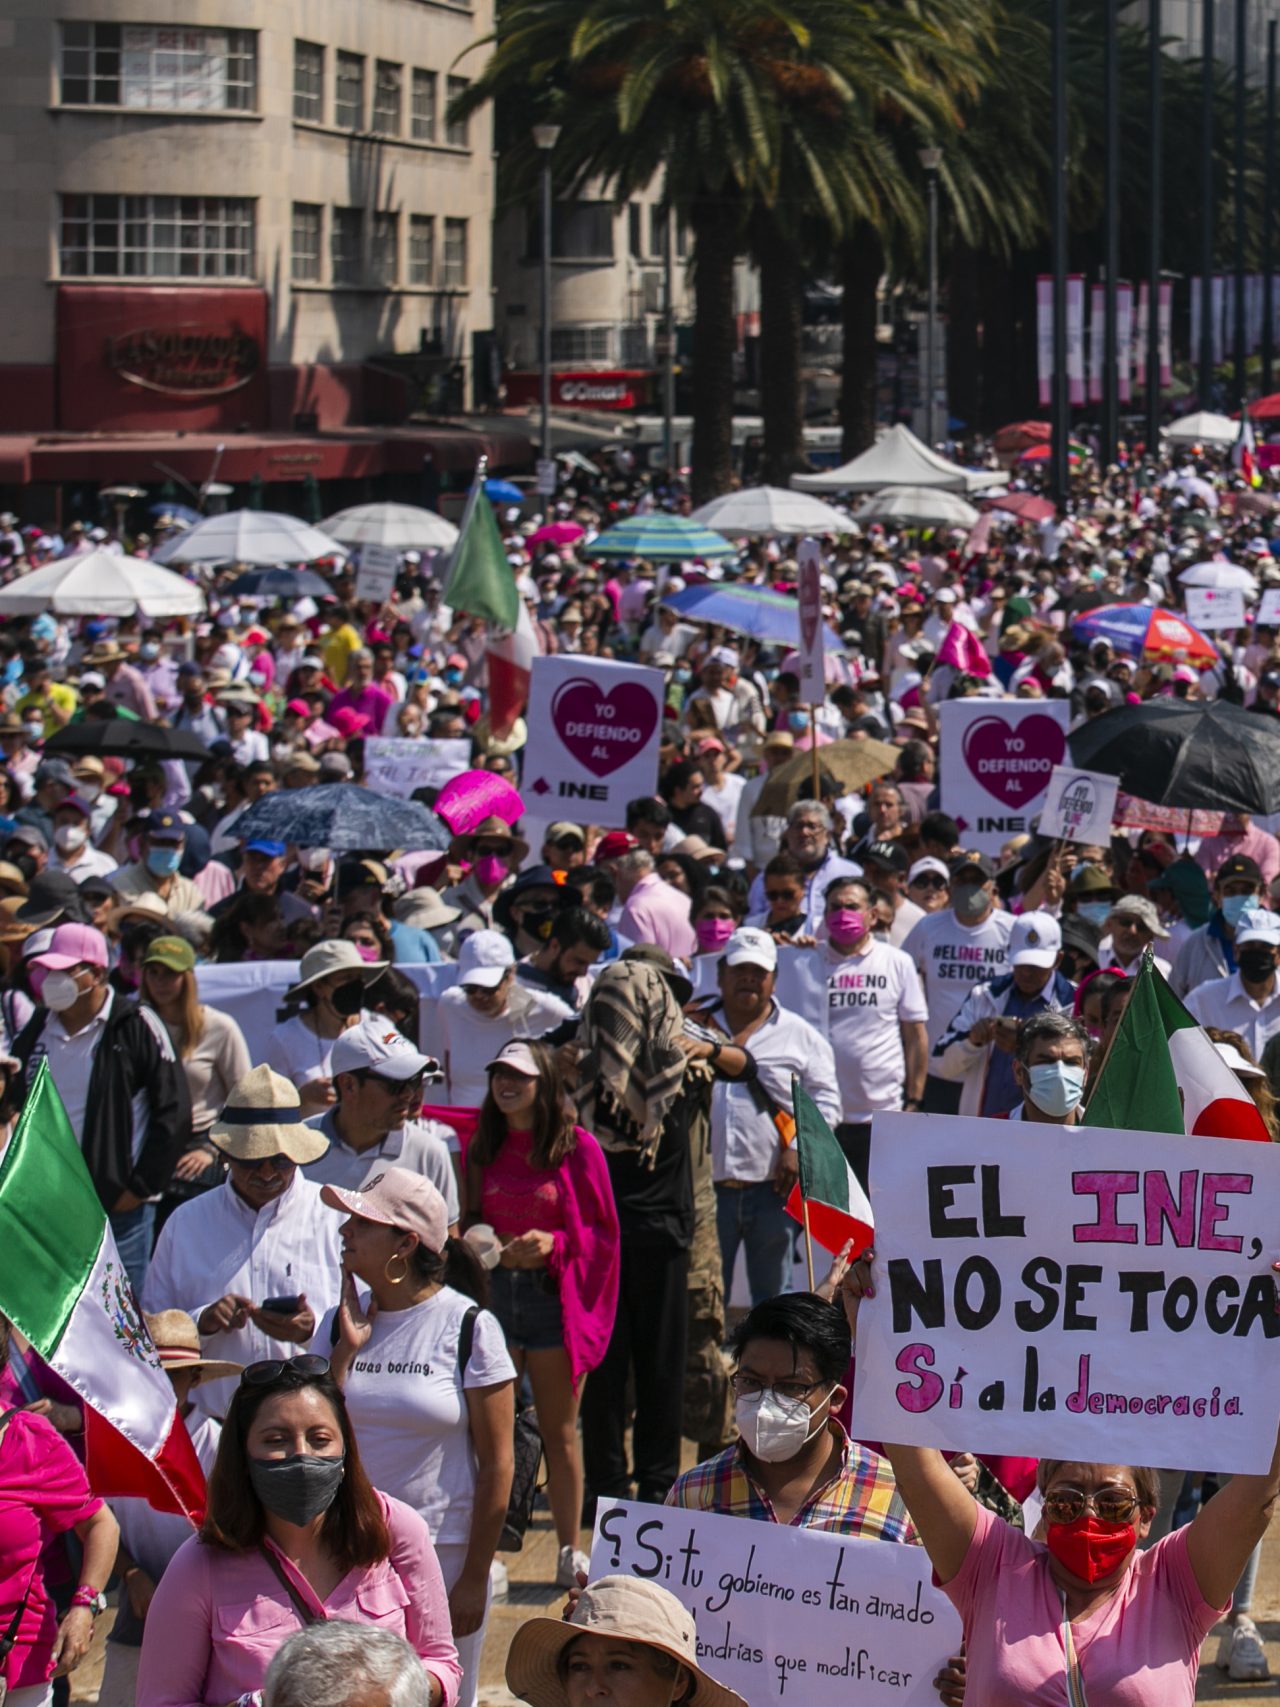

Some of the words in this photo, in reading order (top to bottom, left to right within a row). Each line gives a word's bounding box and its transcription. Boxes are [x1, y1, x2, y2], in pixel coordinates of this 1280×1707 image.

[594, 703, 616, 719] YO
[565, 722, 642, 743] DEFIENDO
[591, 744, 610, 760] AL
[1004, 738, 1025, 752] YO
[978, 758, 1051, 773] DEFIENDO
[559, 781, 609, 801] INE
[1005, 779, 1023, 792] AL
[977, 816, 1026, 833] INE
[938, 962, 996, 980] SETOCA
[927, 1164, 1026, 1238] EL
[1071, 1169, 1263, 1260] INE,
[888, 1255, 1002, 1333] NO
[1014, 1256, 1103, 1332] SE
[388, 1361, 434, 1376] boring.
[895, 1342, 968, 1413] Sí
[978, 1380, 1005, 1411] a
[1023, 1345, 1056, 1412] la
[679, 1528, 703, 1588] tu
[705, 1545, 795, 1612] gobierno
[801, 1590, 821, 1606] es
[826, 1547, 860, 1615] tan
[865, 1580, 934, 1624] amado
[693, 1612, 763, 1664] endrías
[774, 1654, 807, 1695] que
[816, 1647, 913, 1687] modificar
